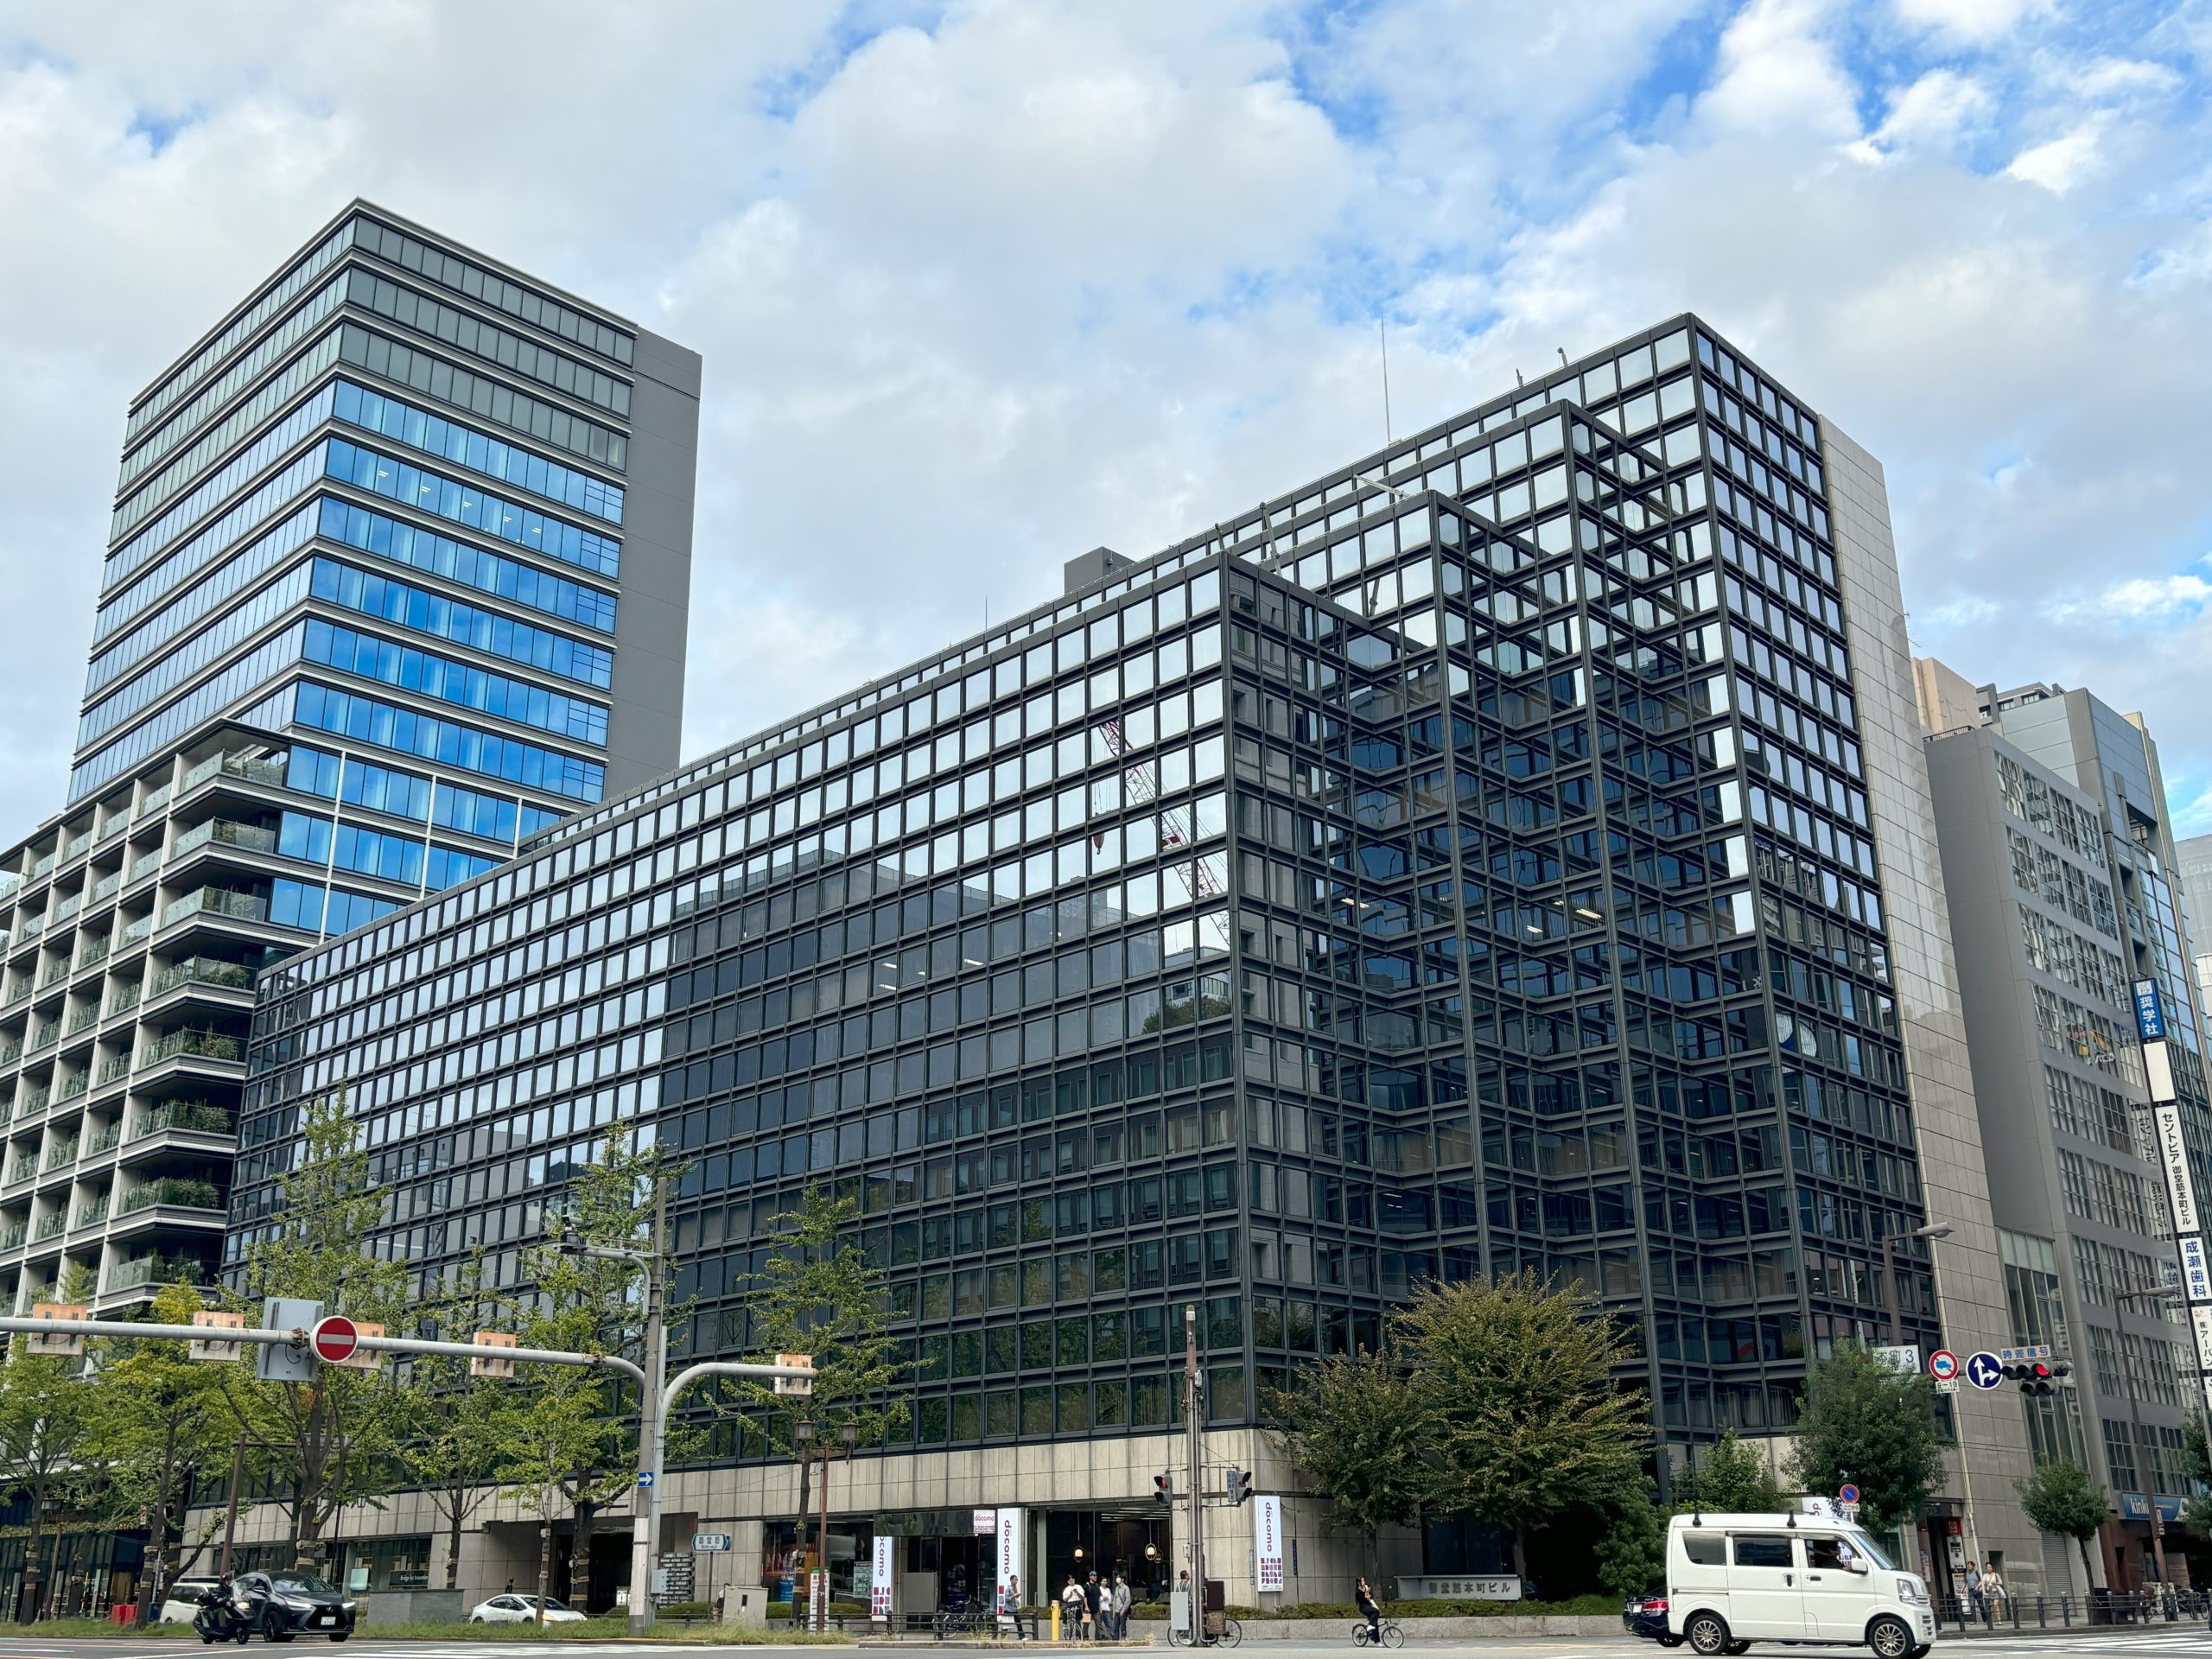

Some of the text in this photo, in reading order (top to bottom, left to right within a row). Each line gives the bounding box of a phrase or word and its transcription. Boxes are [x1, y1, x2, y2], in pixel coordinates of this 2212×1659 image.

[2139, 995, 2158, 1035] 奨学社
[2162, 1112, 2191, 1225] セントピア 御堂筋本町ビル
[2185, 1240, 2207, 1297] 成瀬歯科
